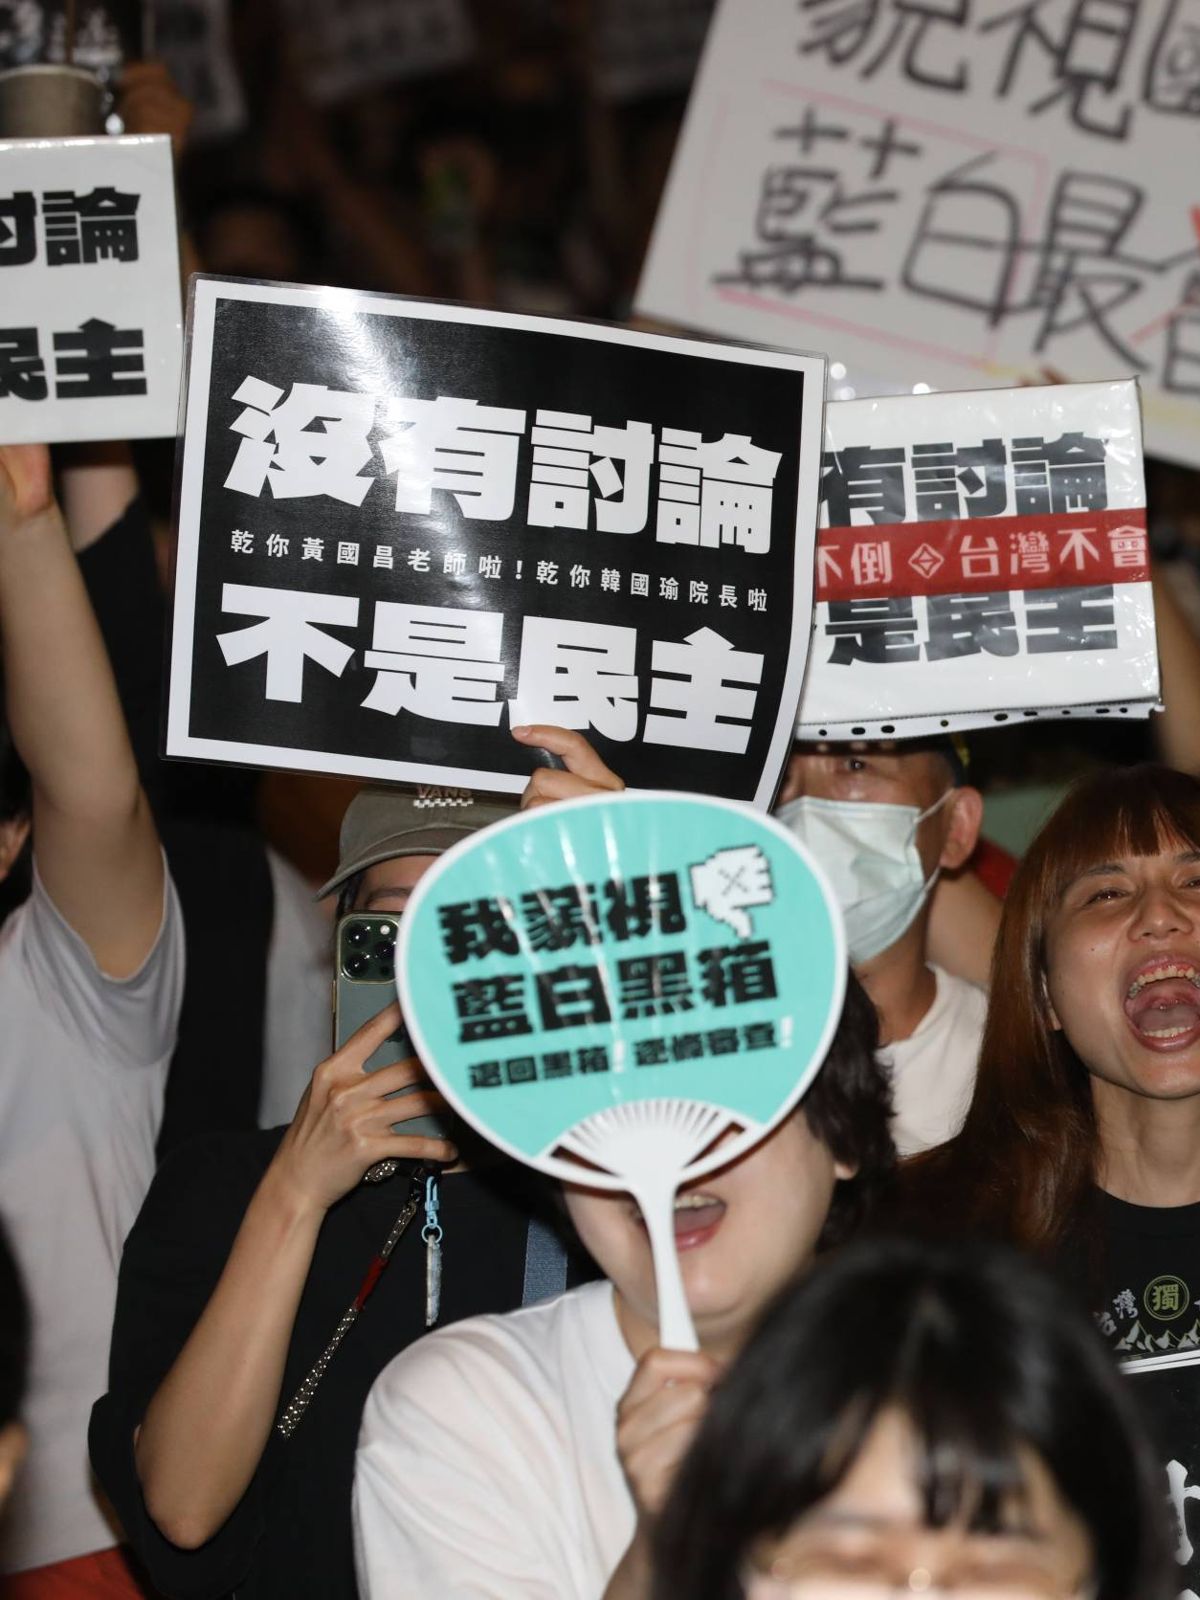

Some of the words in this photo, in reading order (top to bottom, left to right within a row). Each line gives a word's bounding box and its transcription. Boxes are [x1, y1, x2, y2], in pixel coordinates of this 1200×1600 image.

[223, 375, 782, 554] 沒有討論
[959, 525, 1146, 579] 台灣不會
[216, 582, 764, 754] 不是民主
[417, 784, 472, 799] VANS
[437, 872, 686, 965] 我藐視
[453, 940, 777, 1043] 藍白黑箱
